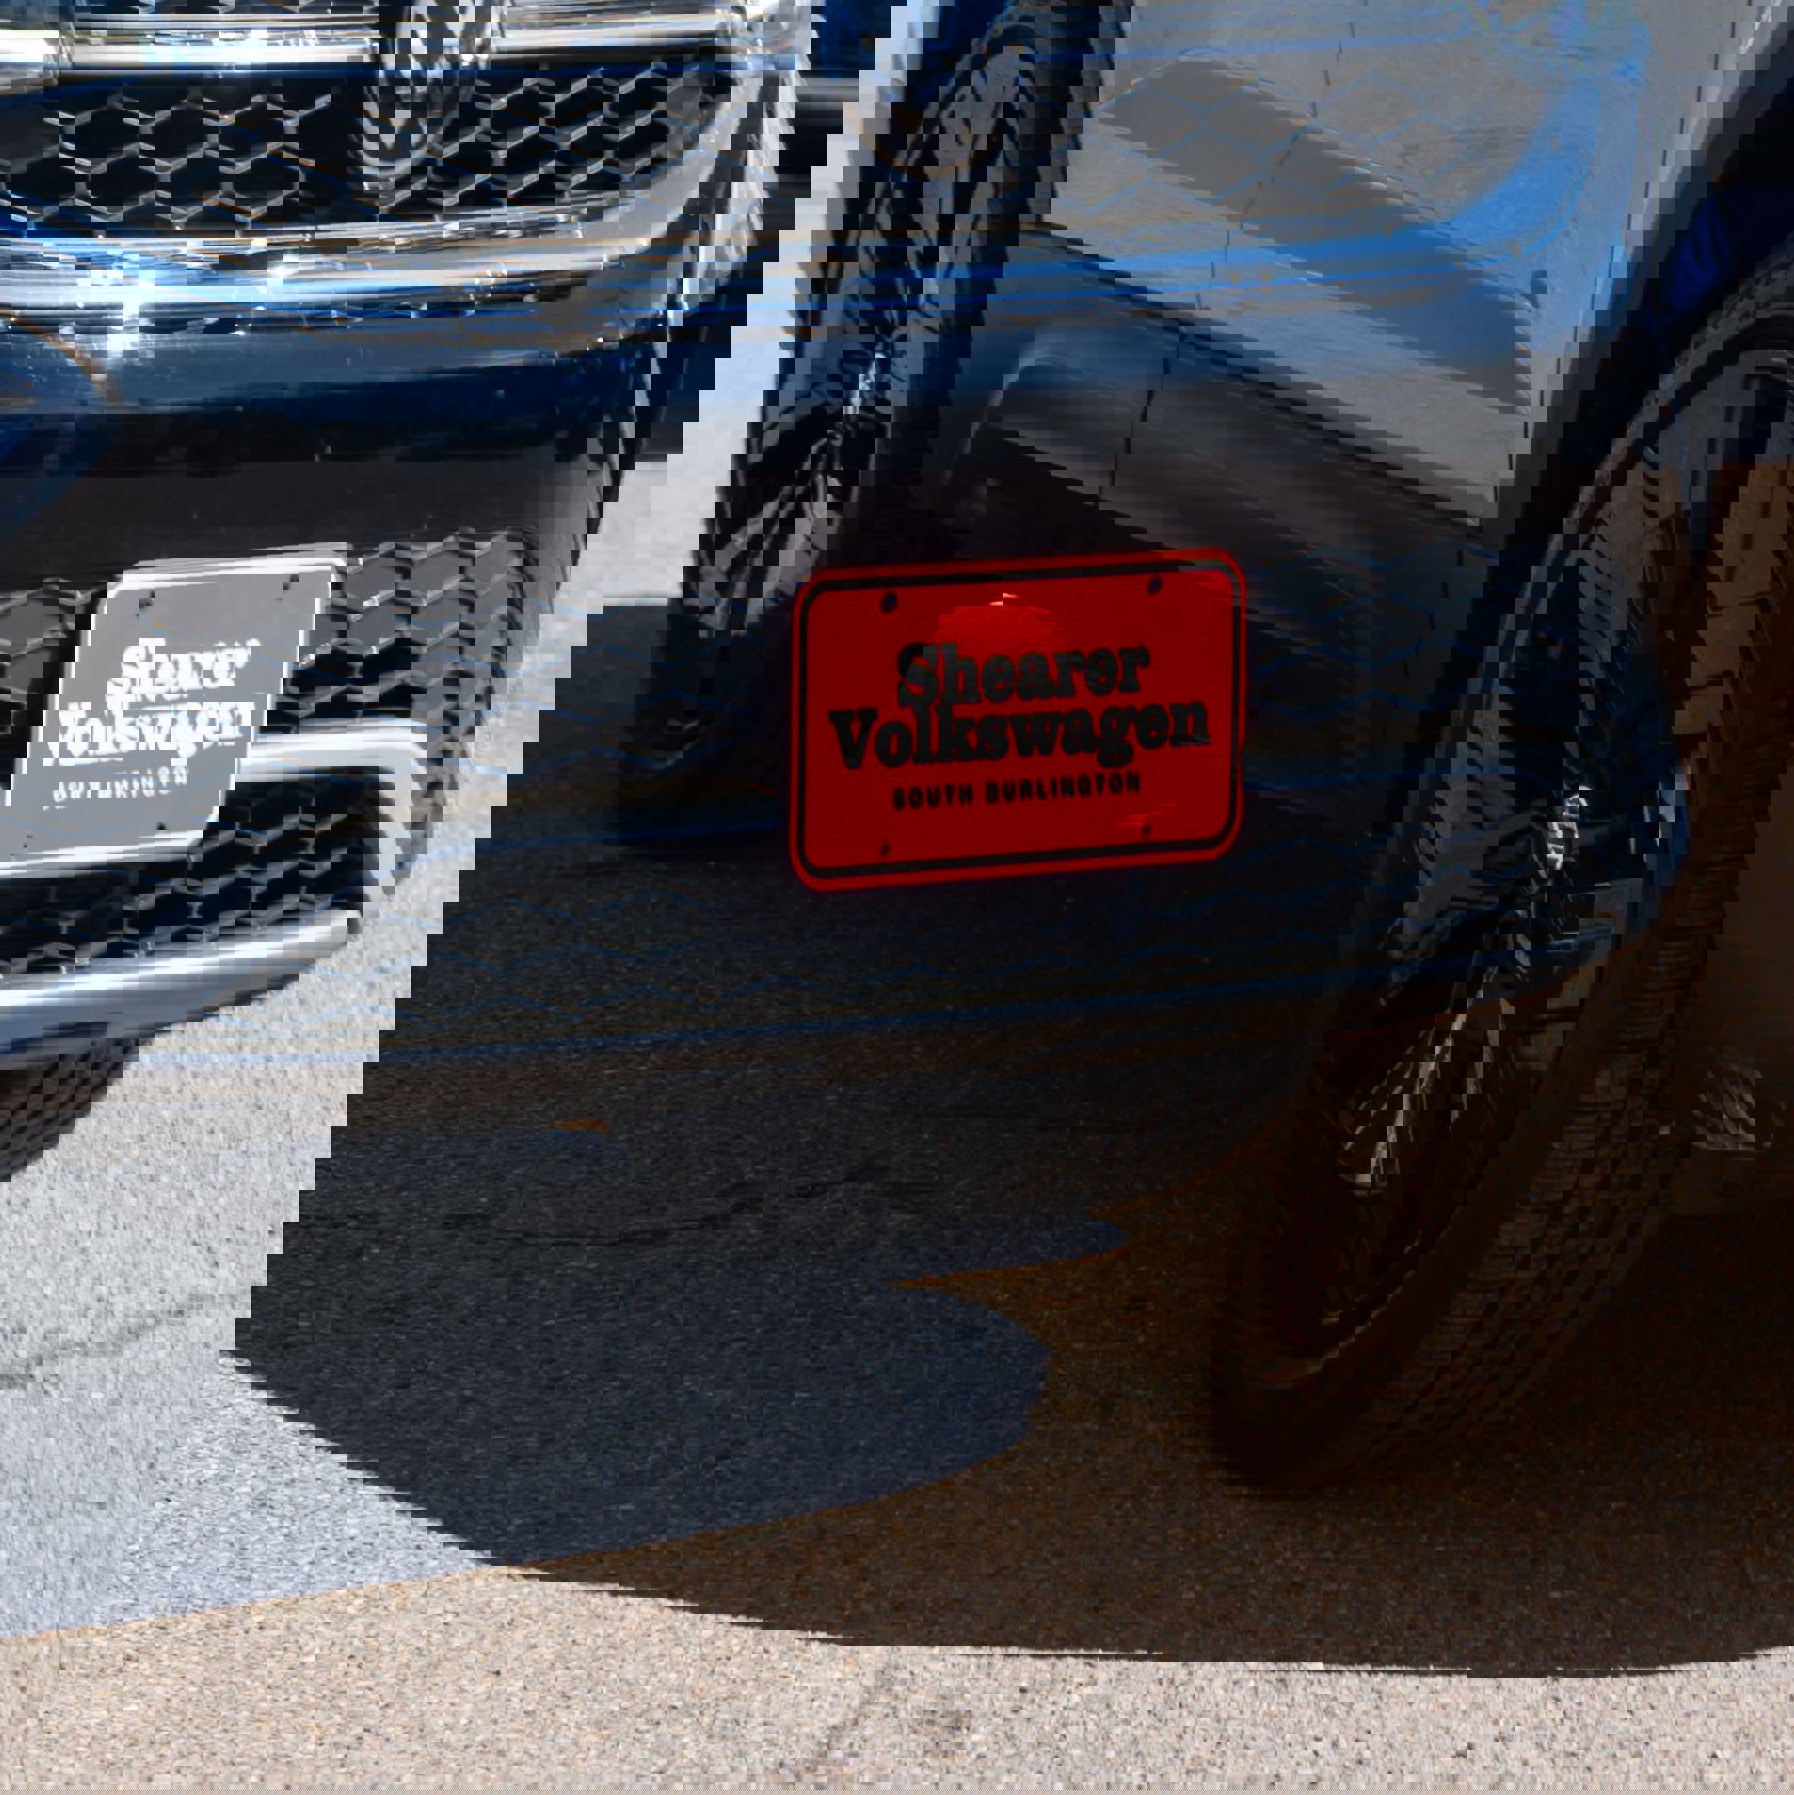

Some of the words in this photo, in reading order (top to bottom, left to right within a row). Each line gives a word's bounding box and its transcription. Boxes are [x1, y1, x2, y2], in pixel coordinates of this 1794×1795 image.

[896, 642, 1151, 707] Shearer
[828, 701, 1211, 769] Volkswagen
[893, 782, 973, 811] SOUTH
[985, 772, 1141, 804] BURLINGTON
